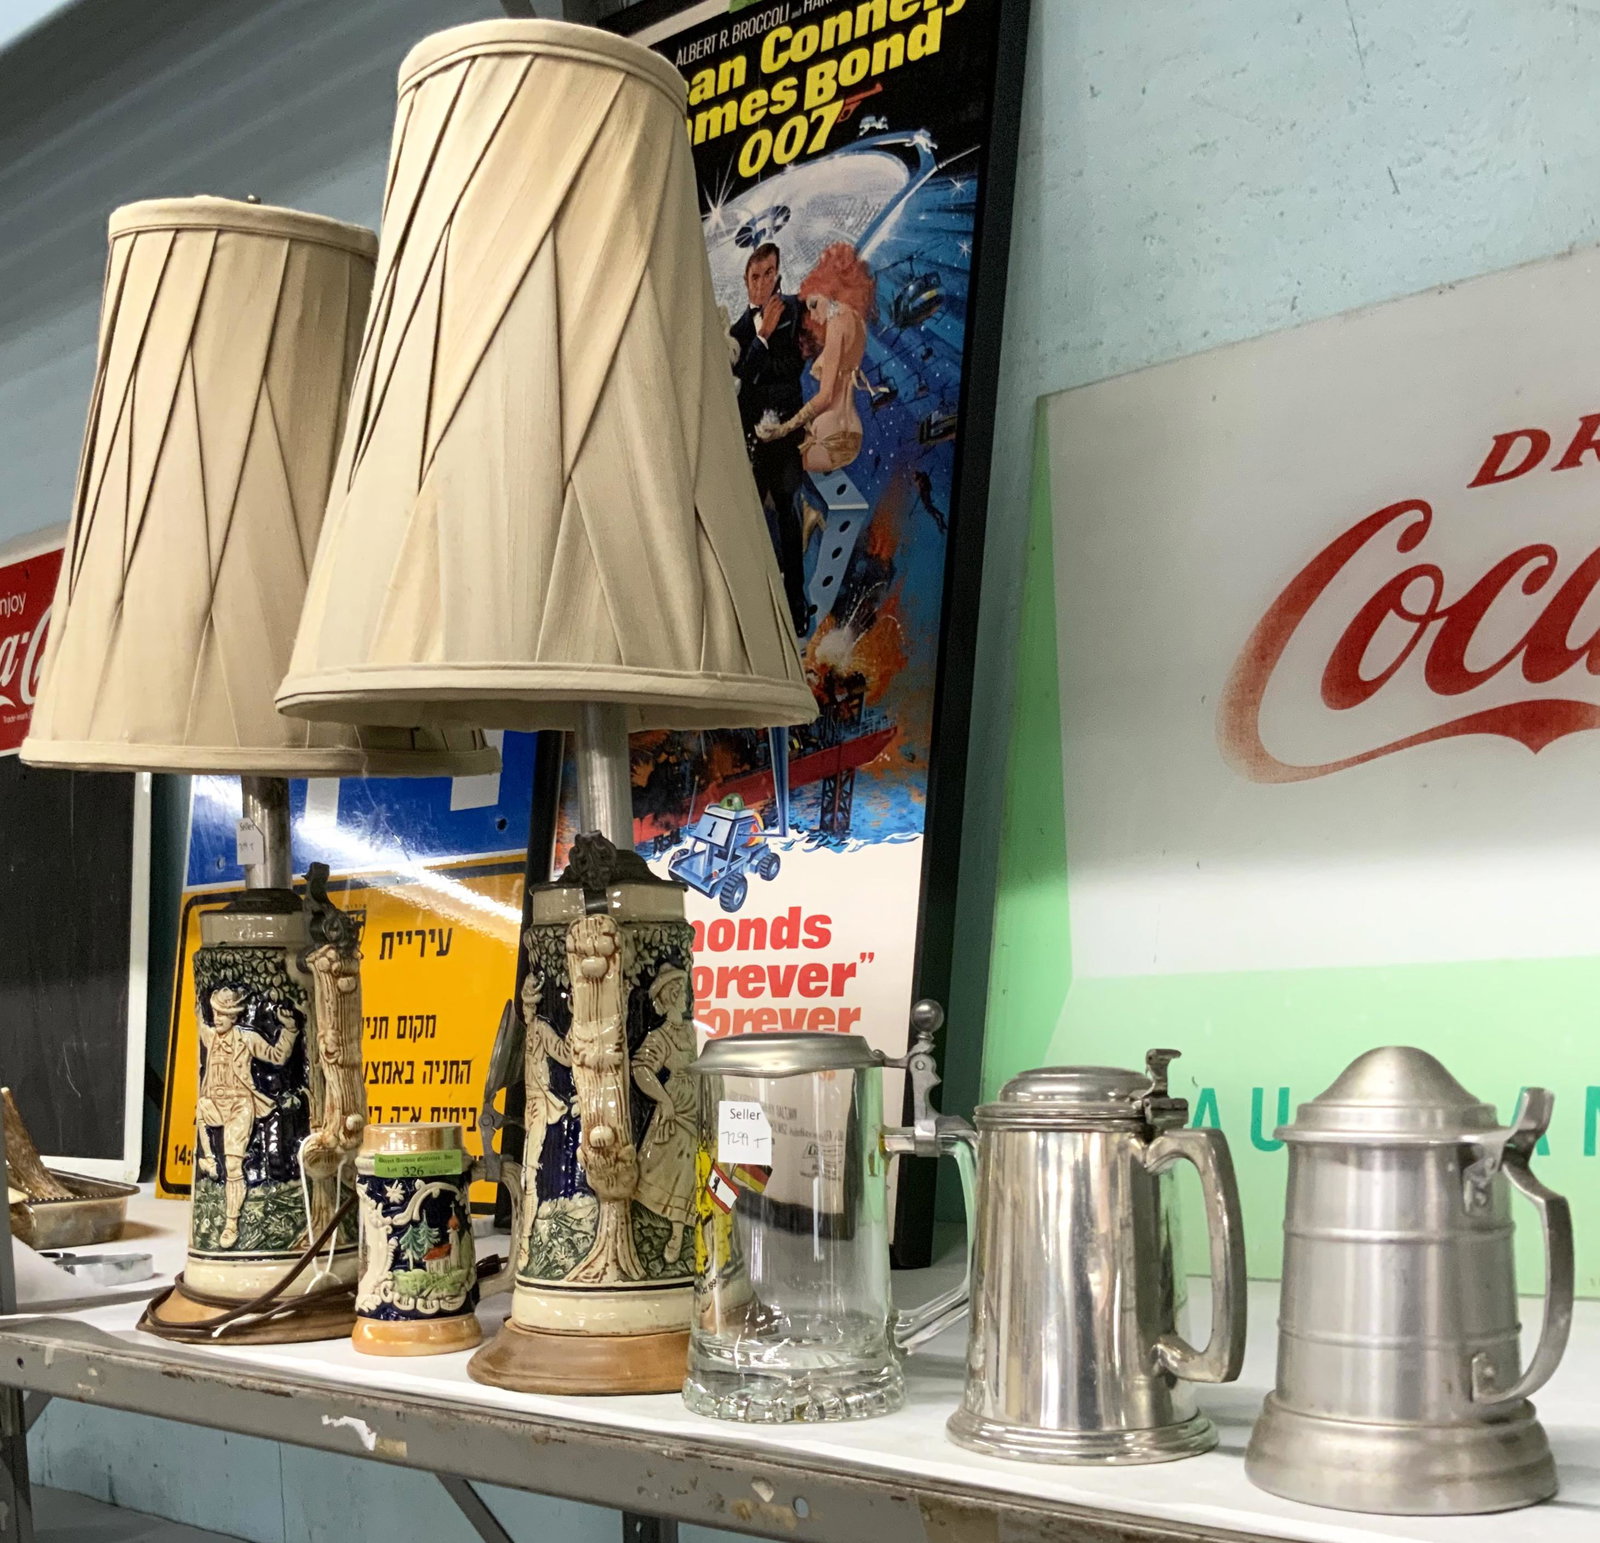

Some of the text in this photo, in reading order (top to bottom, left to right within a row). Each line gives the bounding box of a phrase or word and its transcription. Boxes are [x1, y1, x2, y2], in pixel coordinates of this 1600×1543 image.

[675, 33, 719, 67] ALBERT
[719, 29, 730, 50] R.
[732, 3, 790, 44] BROCCOLI
[685, 55, 747, 106] an
[687, 7, 943, 146] mes Bond
[738, 99, 845, 178] 007
[379, 927, 453, 960] עיריית
[361, 1014, 437, 1043] מקום חני
[422, 1060, 472, 1084] החניה
[730, 1107, 761, 1120] Seller
[174, 1144, 194, 1166] 14:
